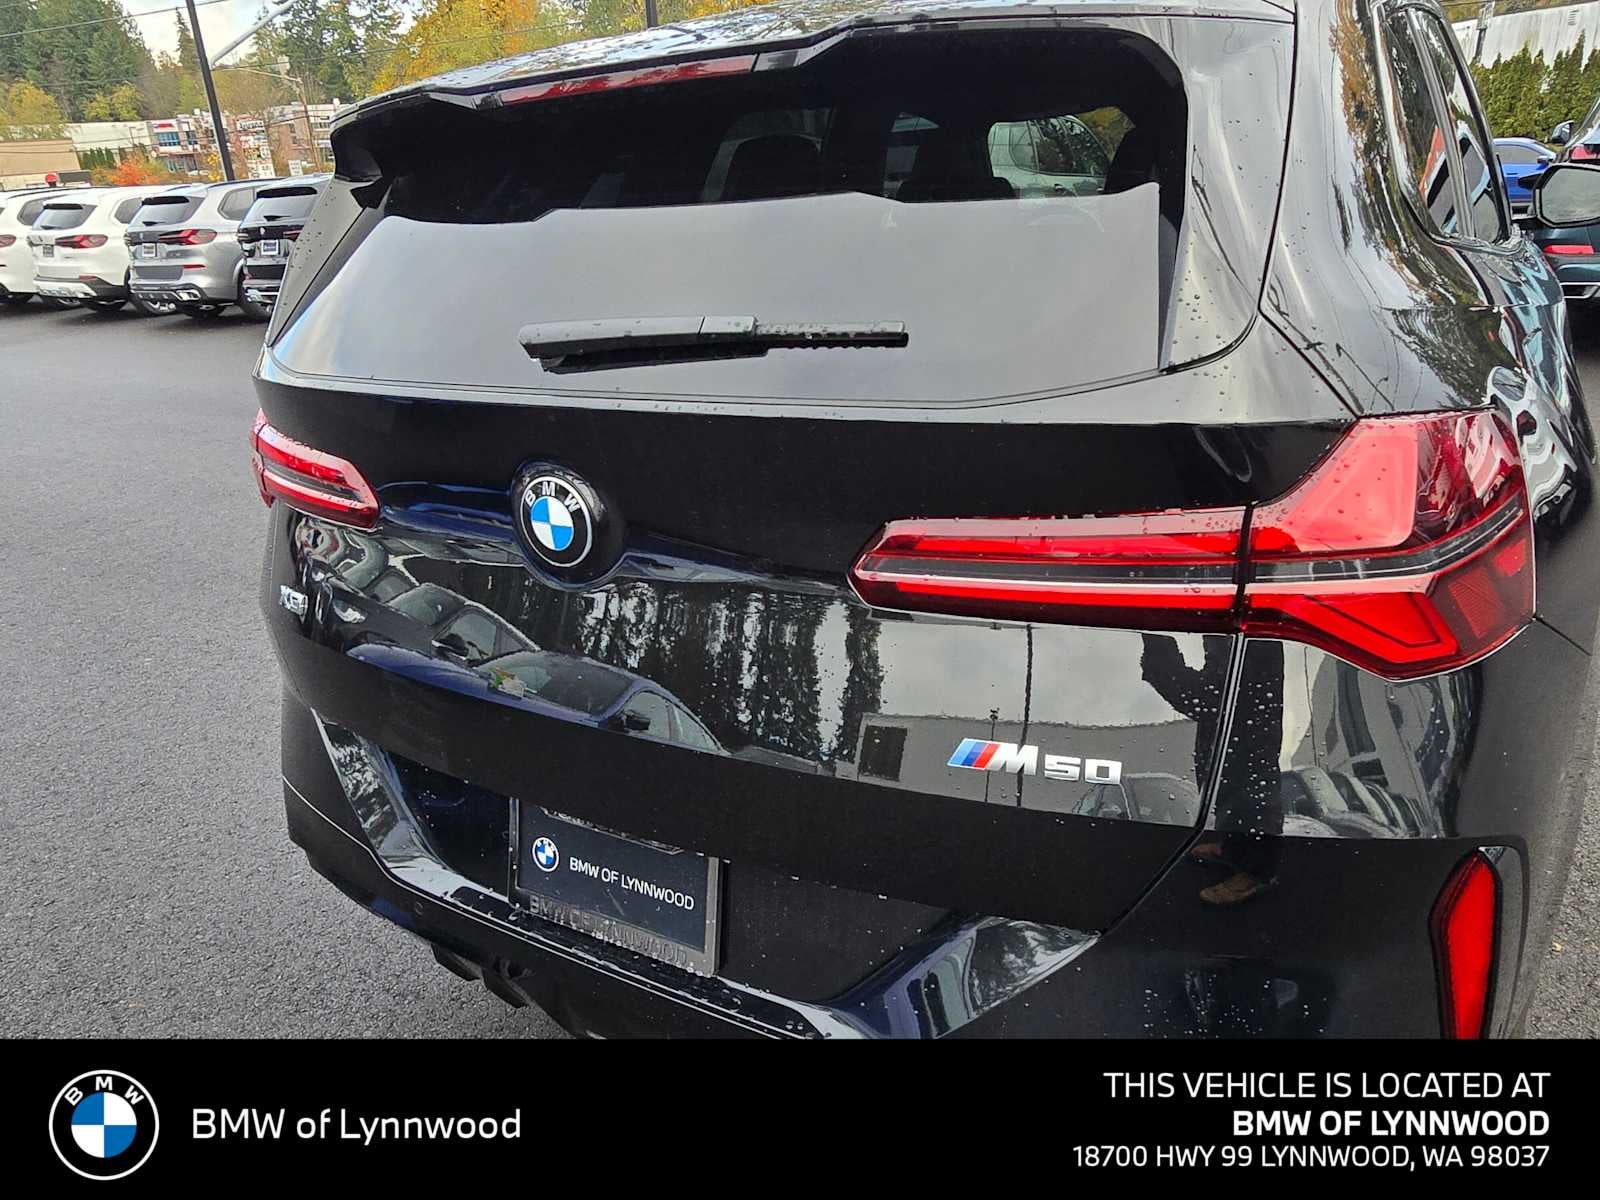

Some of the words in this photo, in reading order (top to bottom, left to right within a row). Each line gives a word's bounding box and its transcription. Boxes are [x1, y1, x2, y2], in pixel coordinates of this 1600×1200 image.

[524, 481, 581, 512] BMW
[569, 857, 599, 878] BMW
[601, 868, 619, 883] OF
[621, 874, 695, 910] LYNNWOOD
